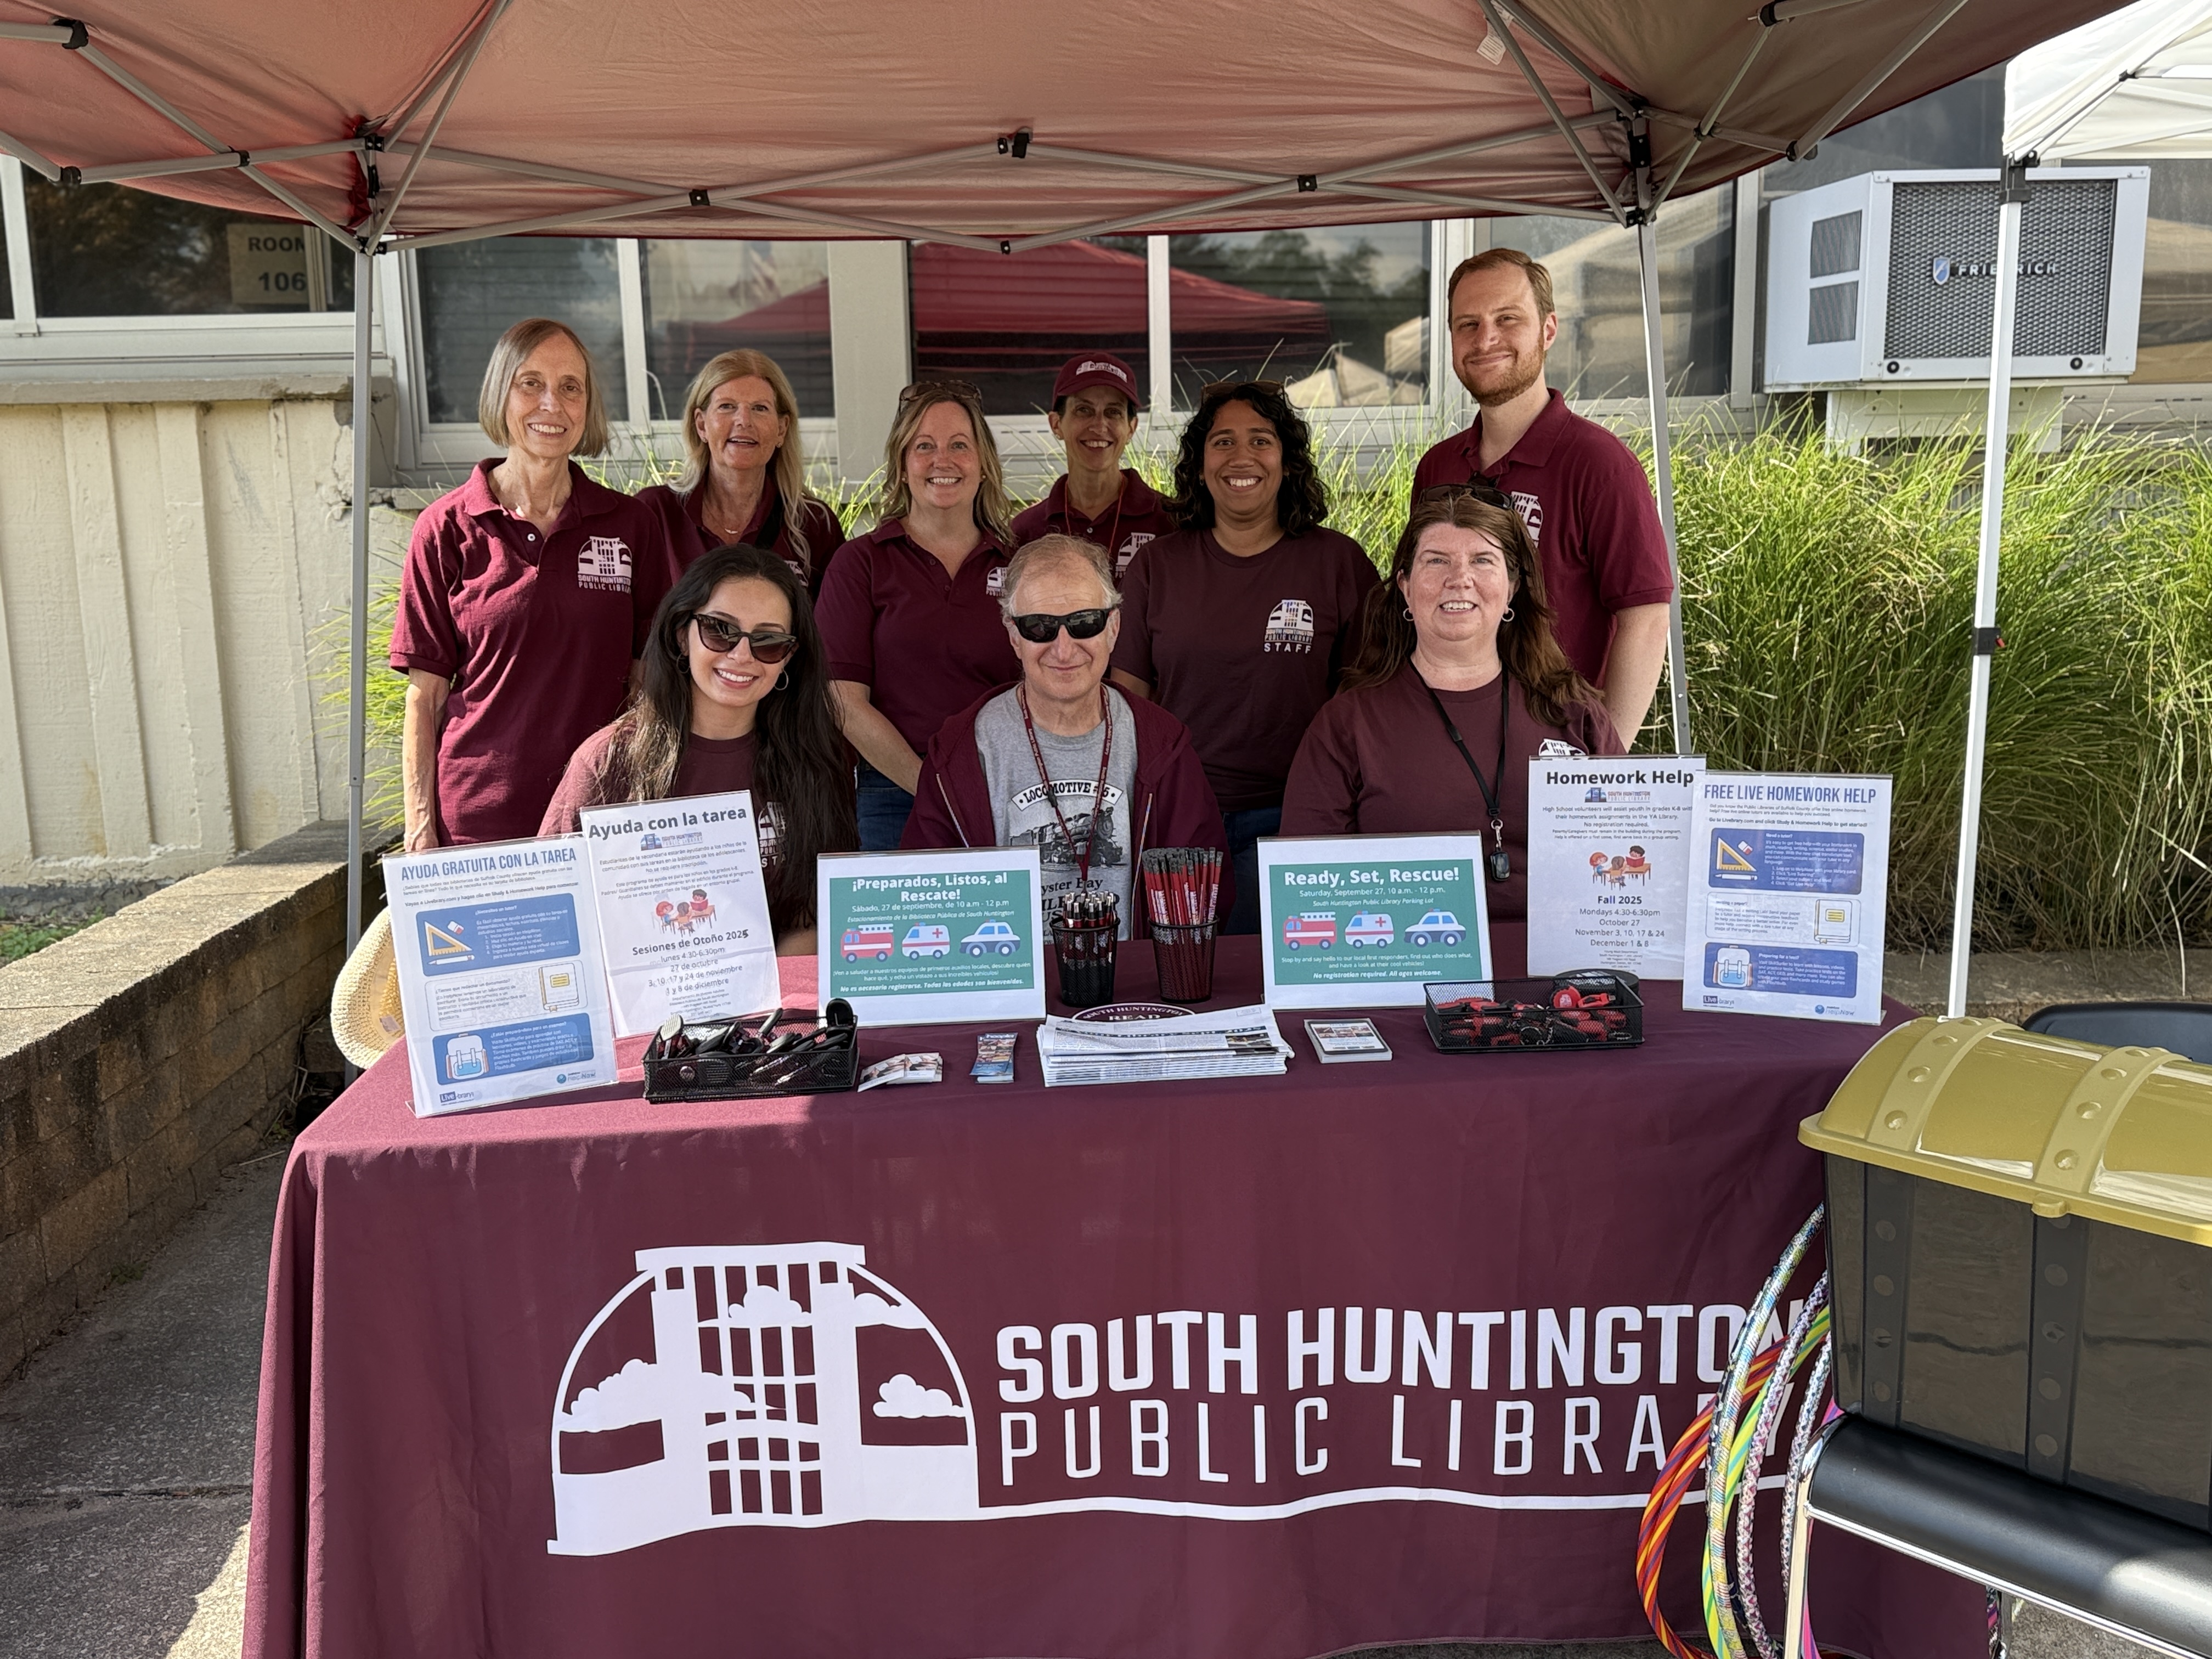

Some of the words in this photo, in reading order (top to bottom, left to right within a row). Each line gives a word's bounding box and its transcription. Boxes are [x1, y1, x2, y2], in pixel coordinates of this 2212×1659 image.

[1958, 263, 2057, 276] FRIERICH
[258, 272, 307, 291] 106
[579, 582, 606, 590] PUBLIC
[1264, 642, 1311, 654] STAFF
[1547, 770, 1646, 784] Homework
[1652, 770, 1694, 787] Help
[1704, 785, 1734, 799] FREE
[1737, 785, 1763, 800] LIVE
[1767, 786, 1840, 802] HOMEWORK
[1843, 788, 1876, 803] HELP
[589, 820, 644, 840] Ayuda
[648, 817, 678, 830] con
[682, 812, 697, 826] la
[702, 808, 746, 823] tarea
[402, 863, 439, 881] AYUDA
[442, 856, 496, 875] GRATUITA
[499, 854, 522, 868] CON
[524, 852, 539, 866] LA
[540, 848, 576, 864] TAREA
[853, 876, 941, 891] ¡Preparados,
[945, 874, 990, 885] Listos,
[994, 872, 1007, 883] al
[1284, 870, 1345, 888] Ready,
[1350, 870, 1384, 884] Set,
[1390, 867, 1459, 882] Rescue!
[901, 888, 960, 901] Rescate!
[1041, 880, 1072, 895] yster
[1334, 889, 1373, 897] September
[902, 902, 943, 911] septiembre,
[1598, 895, 1615, 904] Fall
[1618, 896, 1642, 904] 2025
[1579, 908, 1612, 917] Mondays
[1614, 909, 1660, 917] 4:30-6:30pm
[633, 943, 675, 955] Sesiones
[678, 939, 690, 947] de
[693, 934, 723, 945] Otoño
[725, 929, 749, 940] 2025
[691, 957, 718, 968] octubre
[685, 972, 693, 980] 24
[706, 965, 742, 976] noviembre
[694, 978, 729, 990] diciembre
[997, 1309, 1257, 1404] SOUTH
[1000, 1397, 1330, 1486] PUBLIC
